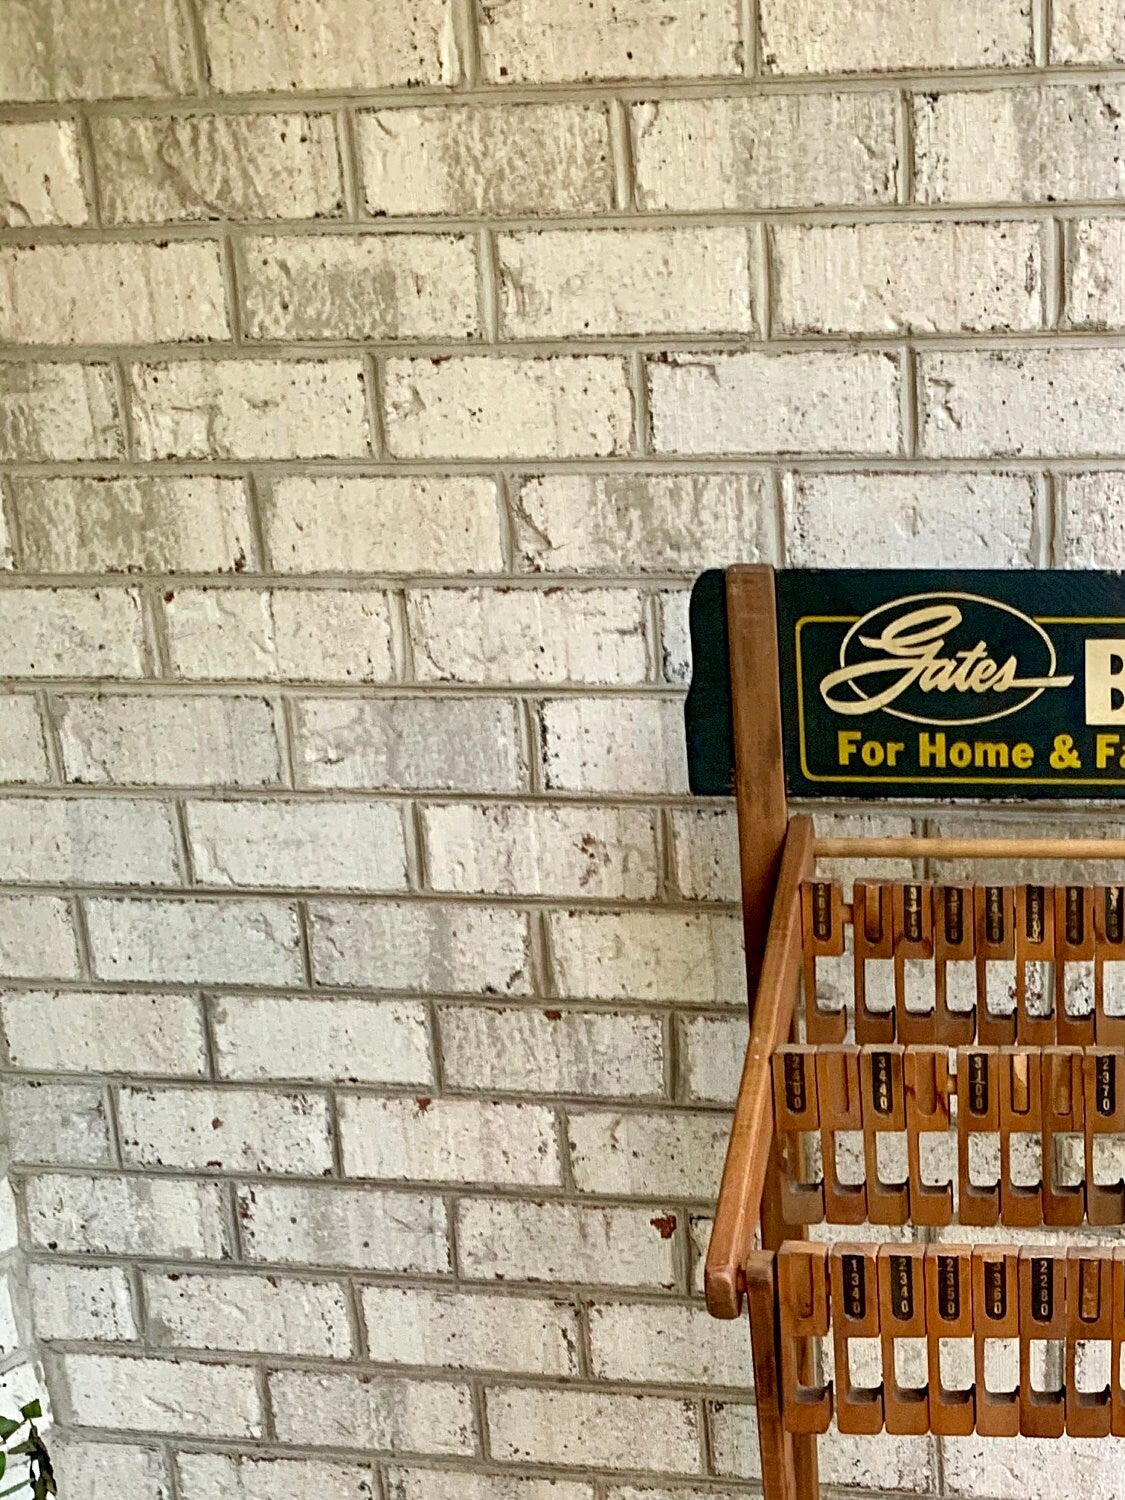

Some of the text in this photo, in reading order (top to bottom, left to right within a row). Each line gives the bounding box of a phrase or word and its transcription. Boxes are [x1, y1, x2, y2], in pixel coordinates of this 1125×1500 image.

[819, 604, 1075, 715] Gates
[838, 731, 903, 770] For
[919, 733, 1034, 770] Home
[1049, 734, 1081, 771] &
